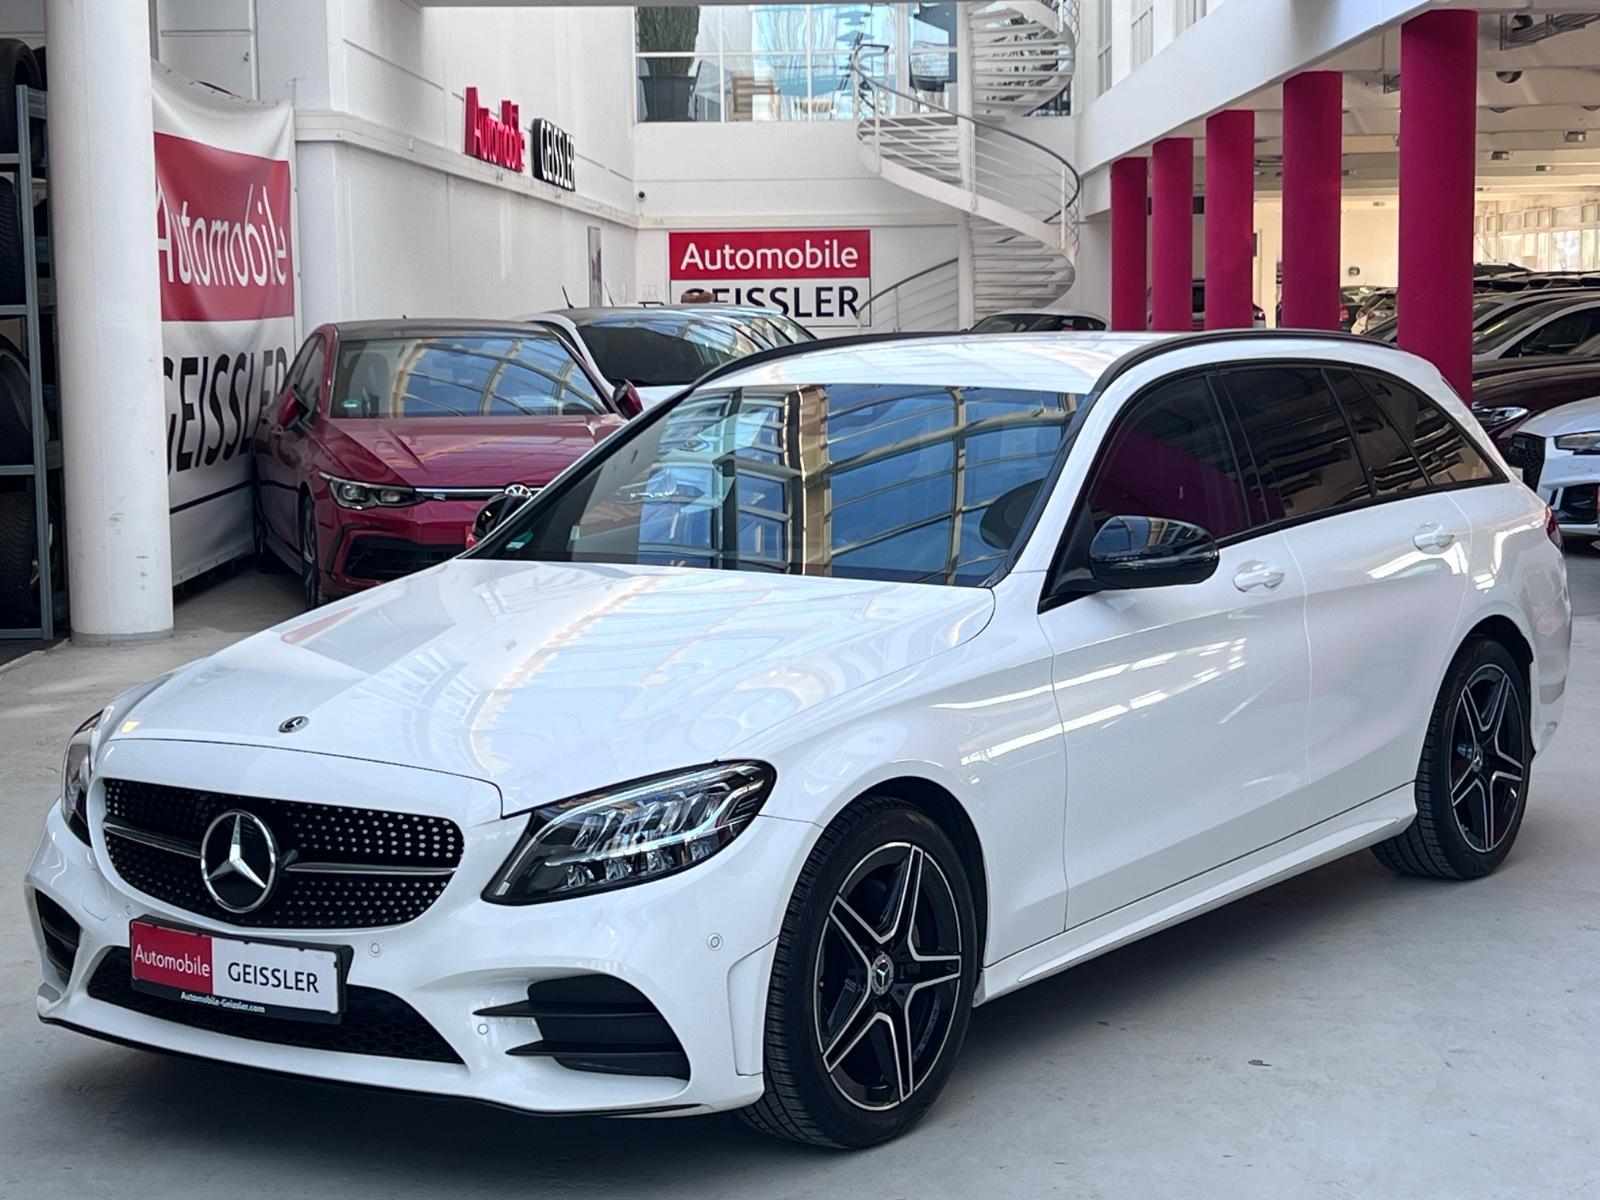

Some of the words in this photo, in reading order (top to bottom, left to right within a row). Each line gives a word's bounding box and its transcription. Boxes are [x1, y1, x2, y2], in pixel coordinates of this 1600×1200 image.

[464, 86, 525, 173] Automobile
[538, 118, 575, 191] GEISSLER
[155, 178, 288, 288] Automobile
[680, 238, 859, 271] Automobile
[681, 285, 860, 318] EISSLER
[134, 943, 211, 978] Automobile
[227, 961, 319, 994] GEISSLER
